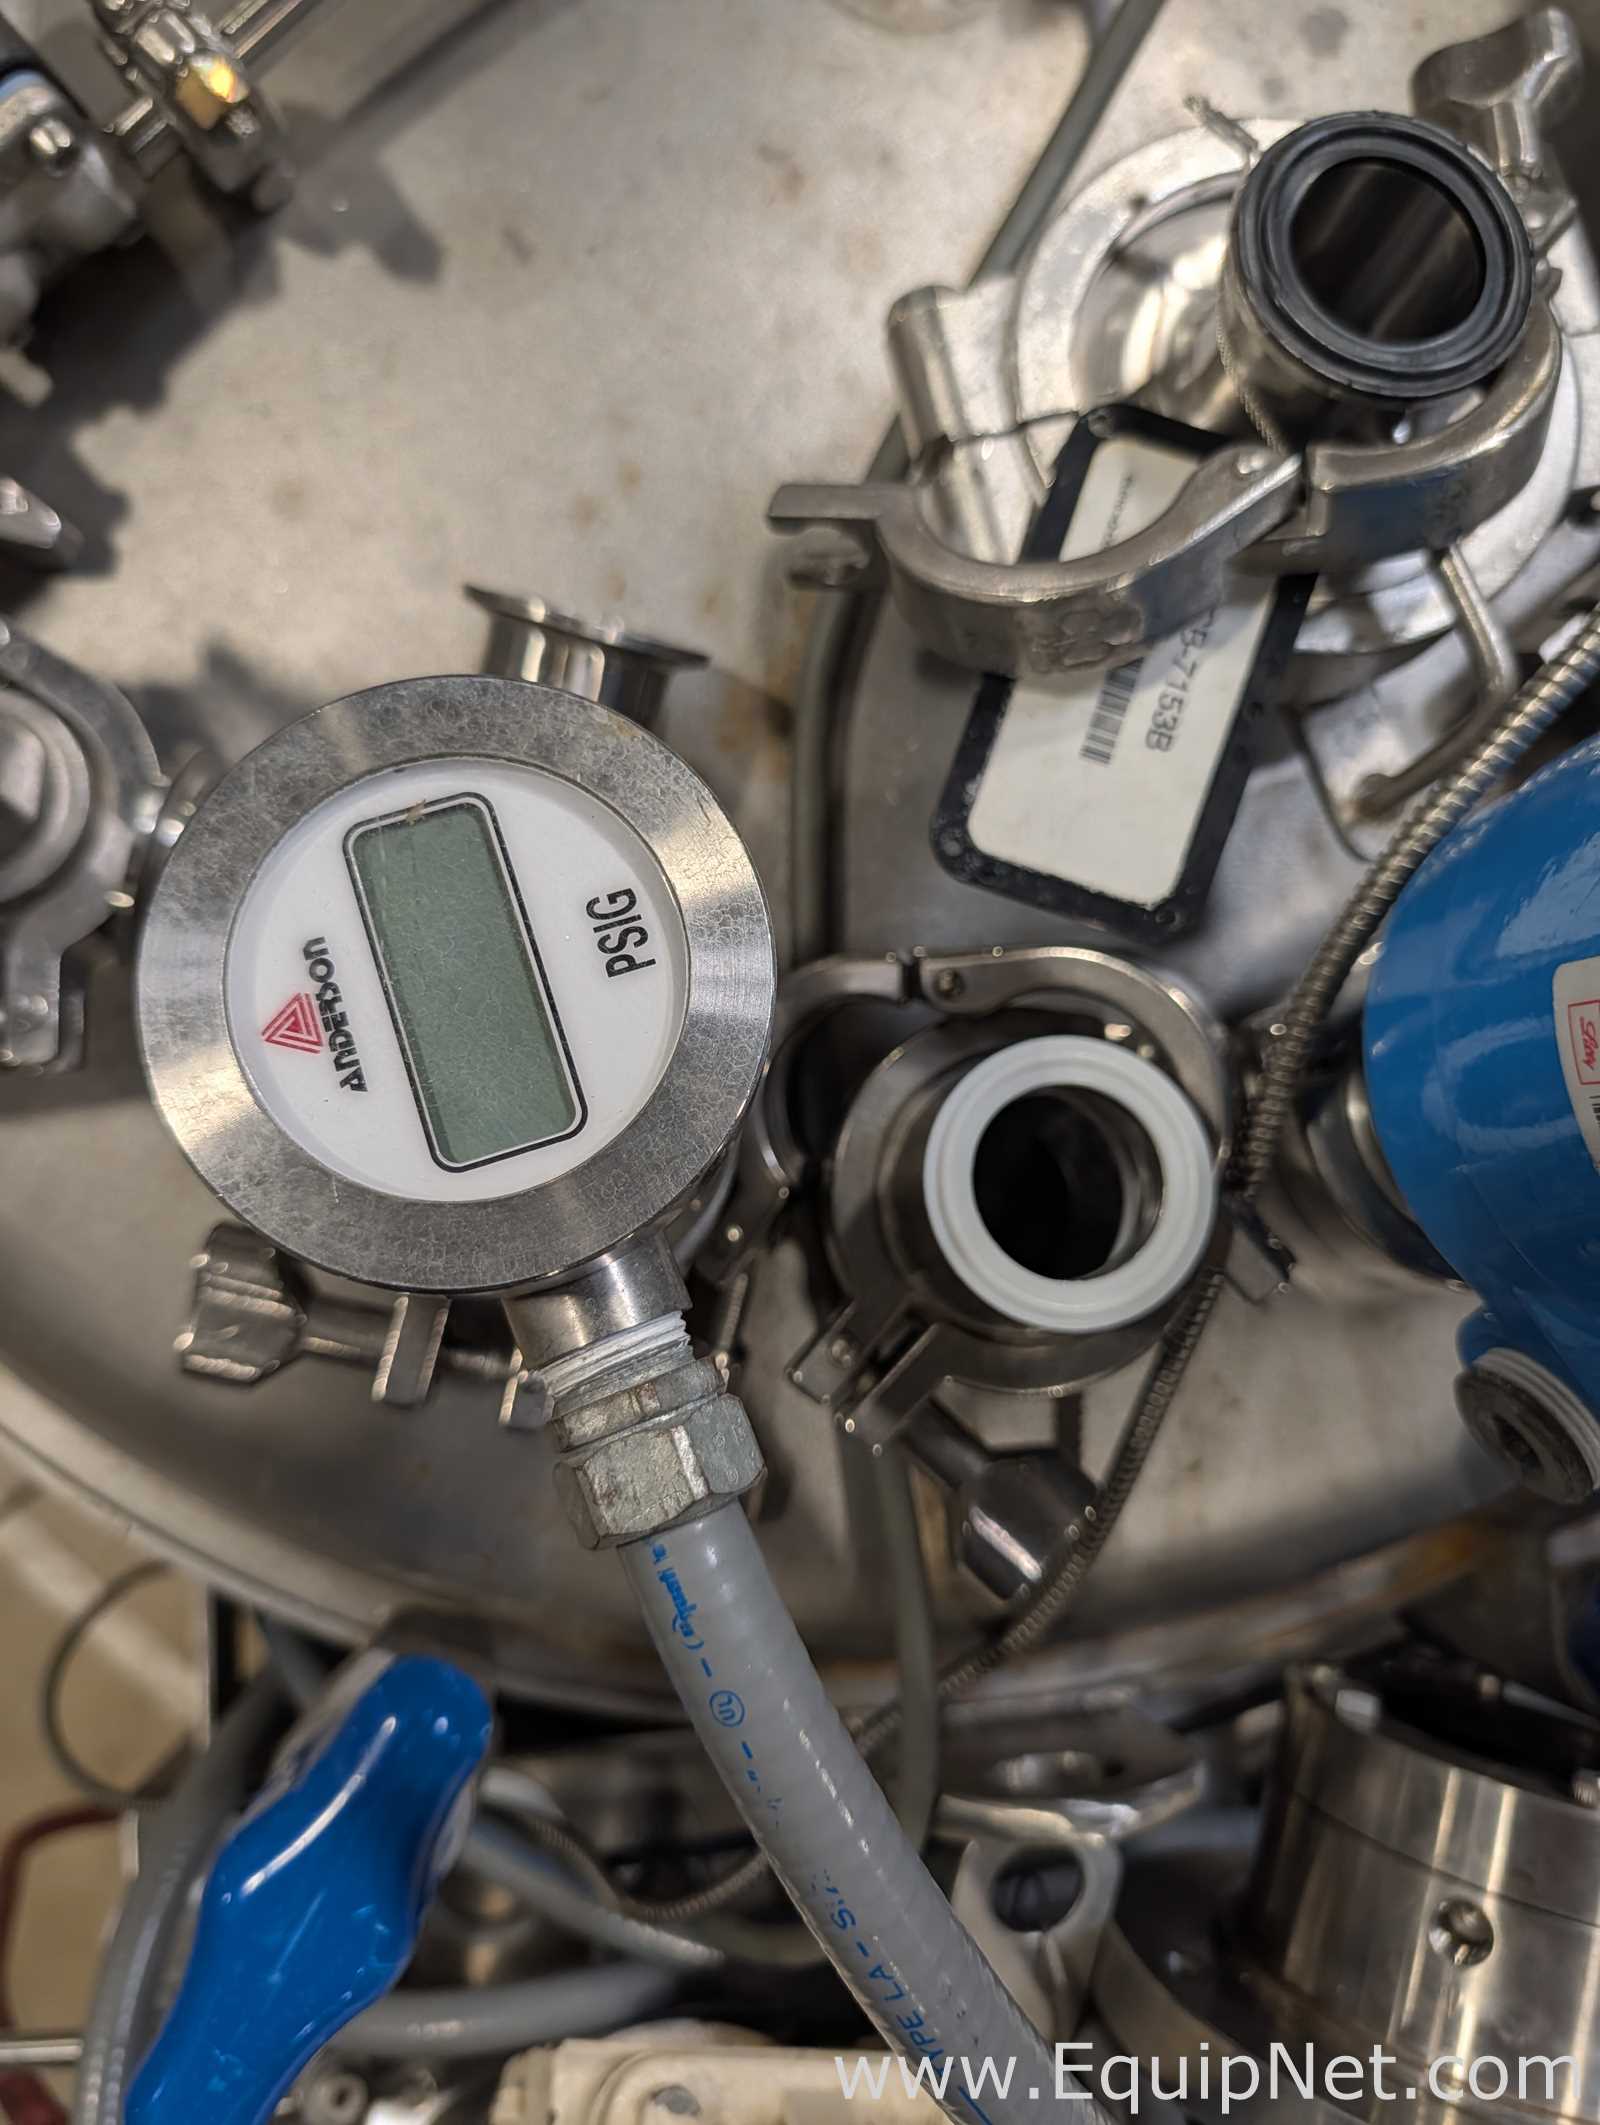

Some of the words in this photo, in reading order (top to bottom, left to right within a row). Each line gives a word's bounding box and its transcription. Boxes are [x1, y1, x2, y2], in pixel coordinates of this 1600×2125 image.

[586, 888, 657, 978] PSIG
[302, 936, 368, 1092] ANDERSON
[869, 1965, 905, 2001] LA
